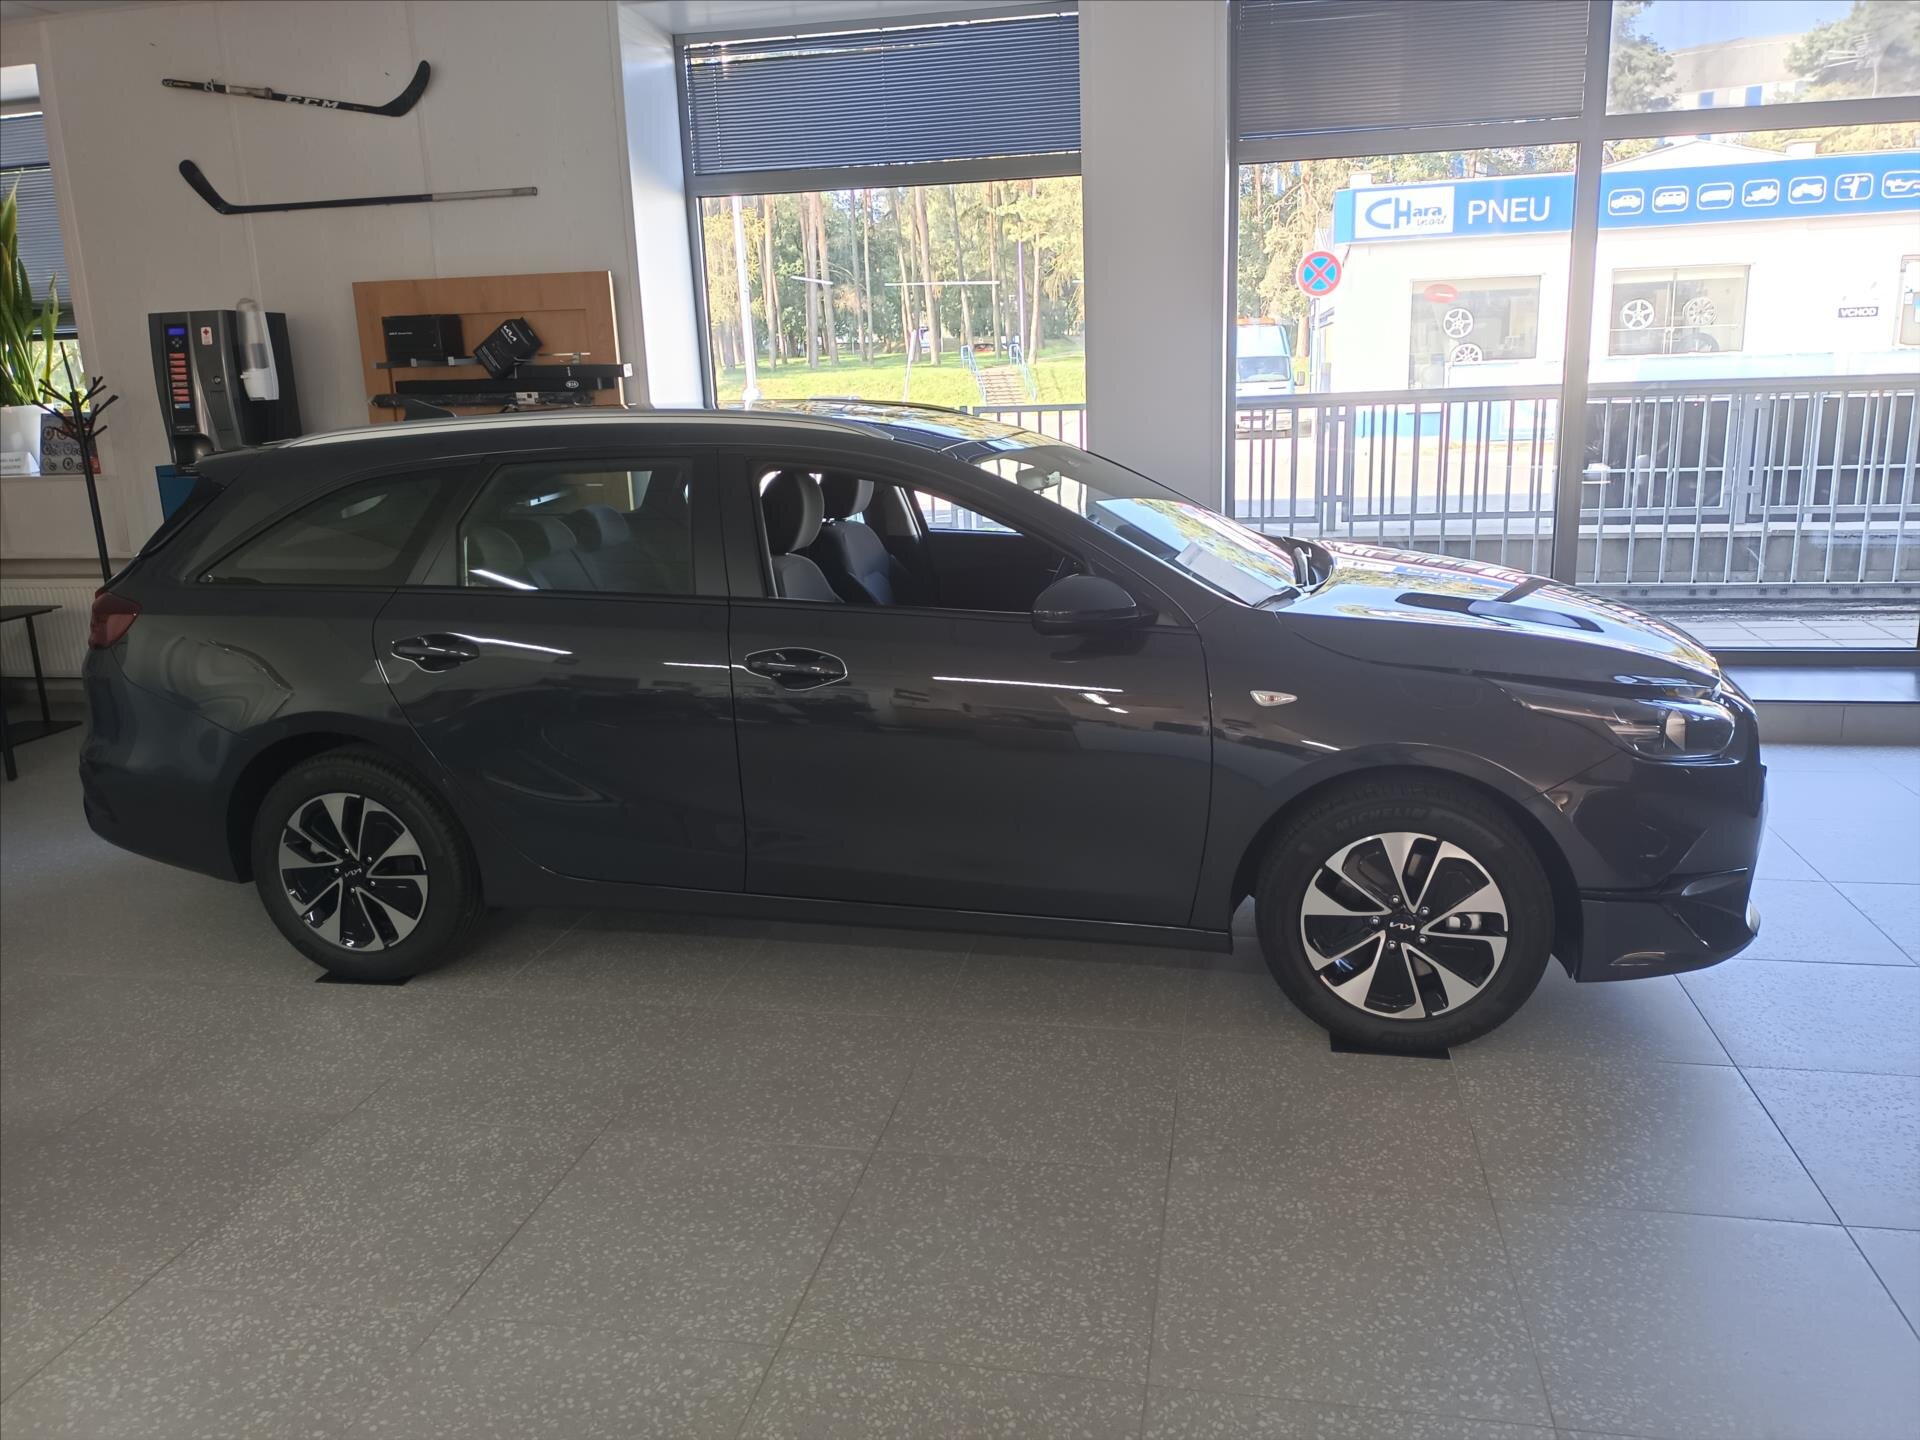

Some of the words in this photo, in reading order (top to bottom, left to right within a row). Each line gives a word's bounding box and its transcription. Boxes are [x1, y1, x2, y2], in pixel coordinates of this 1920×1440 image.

[285, 95, 339, 109] CCM
[1467, 196, 1550, 224] PNEU
[1336, 807, 1428, 831] MICHELIN
